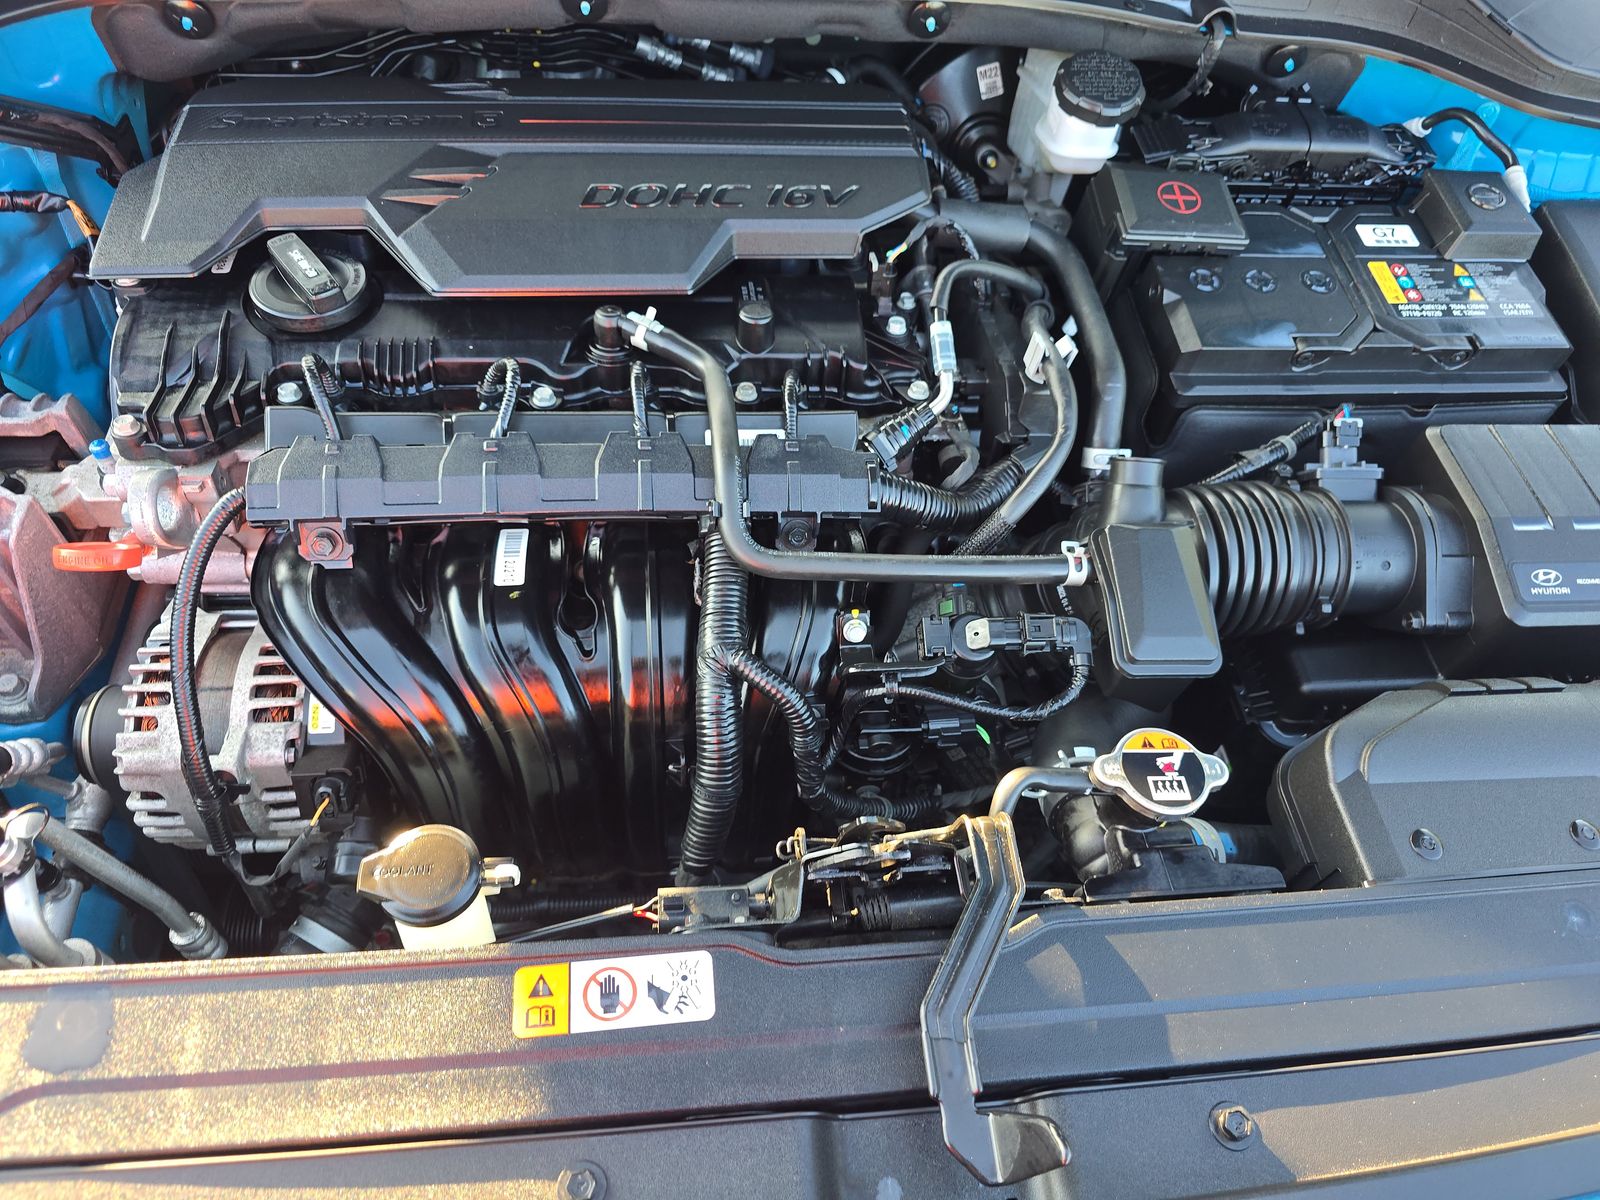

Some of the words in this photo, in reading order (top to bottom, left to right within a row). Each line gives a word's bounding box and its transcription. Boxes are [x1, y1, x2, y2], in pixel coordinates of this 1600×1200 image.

[979, 65, 1000, 80] M22
[578, 183, 752, 209] DOHC
[765, 183, 860, 209] 16V
[1372, 227, 1395, 238] G7
[1531, 587, 1571, 595] HYUNDAI
[373, 863, 434, 879] COOLANT
